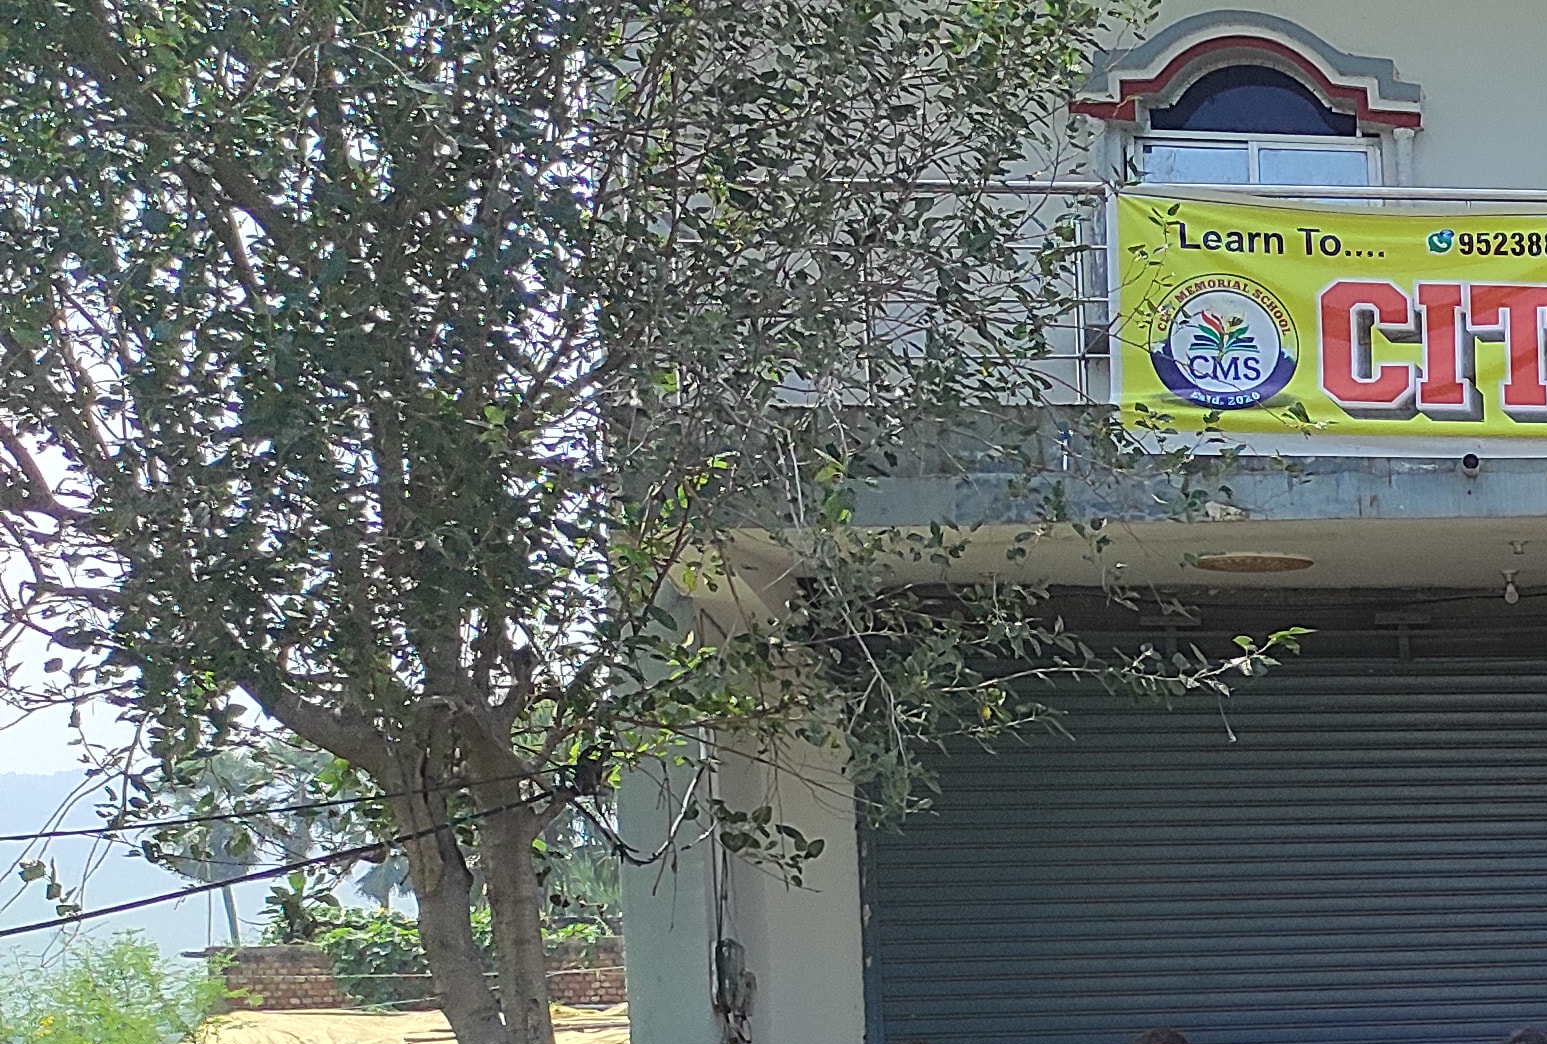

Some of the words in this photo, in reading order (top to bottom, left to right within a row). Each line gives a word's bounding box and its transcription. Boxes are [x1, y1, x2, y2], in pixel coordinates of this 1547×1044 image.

[1179, 222, 1285, 255] Learn
[1174, 278, 1250, 304] MEMORIAL
[1252, 288, 1292, 337] SCHOOL
[1189, 354, 1261, 381] CMS
[1227, 391, 1261, 406] 2020
